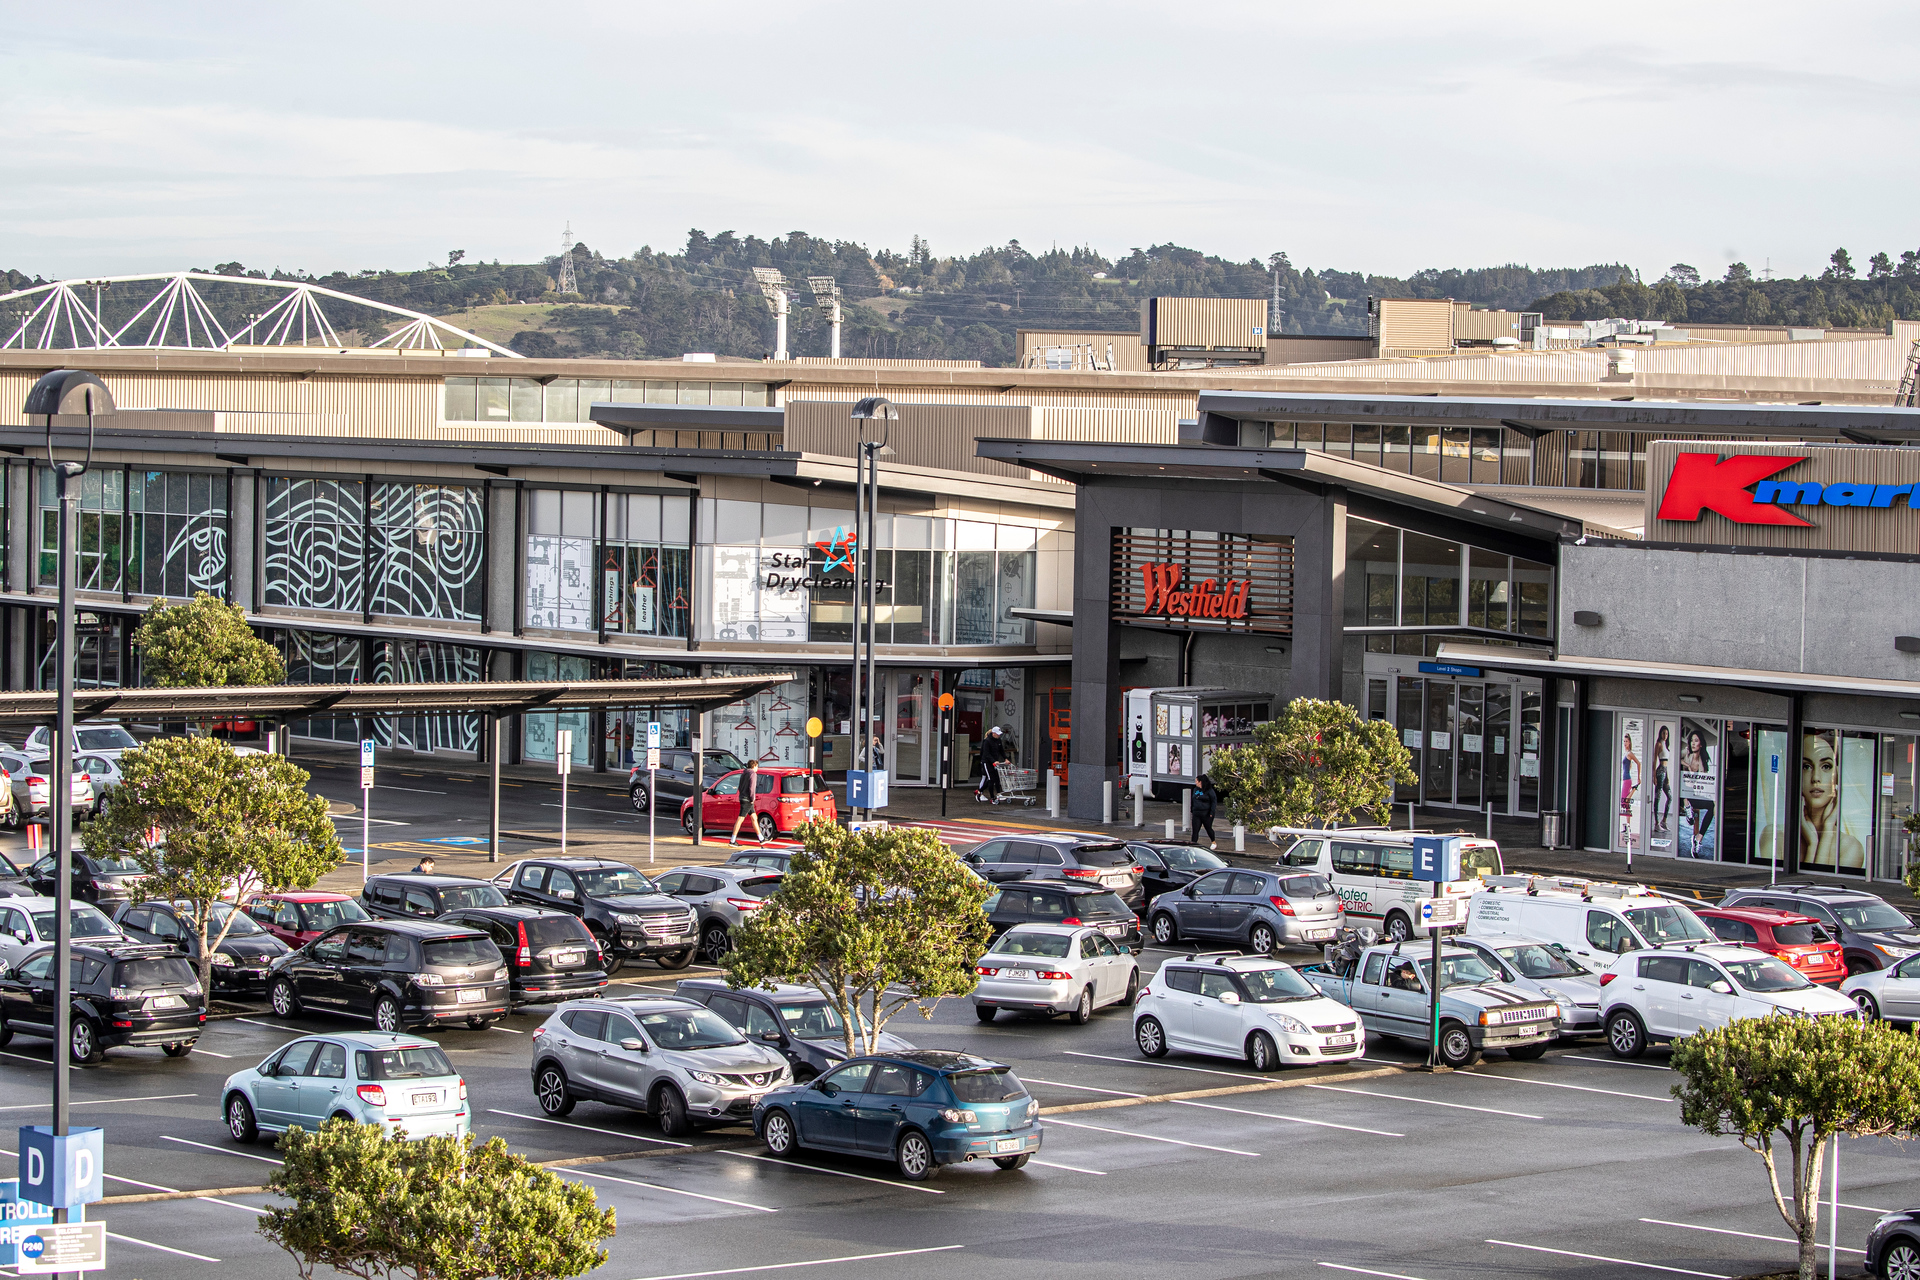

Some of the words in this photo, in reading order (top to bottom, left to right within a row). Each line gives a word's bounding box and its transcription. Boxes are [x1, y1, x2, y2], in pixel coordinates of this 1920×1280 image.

[771, 552, 810, 569] Star
[766, 572, 884, 594] Drycleanng
[1138, 562, 1253, 619] Westfield
[1682, 773, 1716, 781] SKECHERS
[853, 779, 862, 798] F
[878, 780, 884, 799] F
[1421, 848, 1434, 871] E
[1451, 848, 1457, 871] E
[1338, 886, 1368, 902] Aotea
[1341, 900, 1372, 912] ECTRIC
[414, 1094, 436, 1104] ETA193
[28, 1146, 45, 1186] D
[75, 1148, 94, 1189] D
[0, 1201, 54, 1220] TROLLE
[23, 1242, 43, 1251] P240
